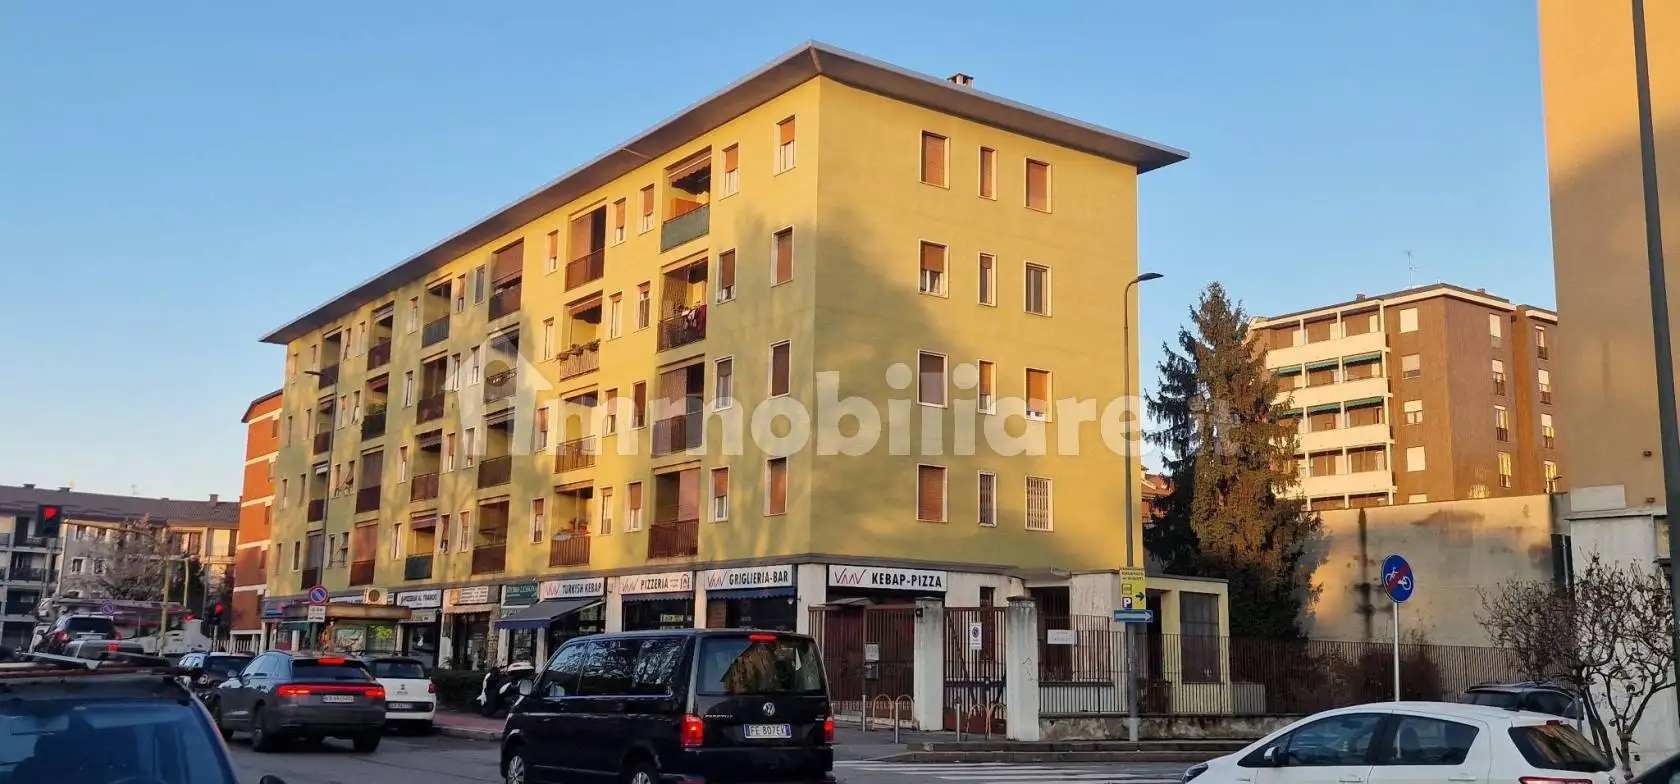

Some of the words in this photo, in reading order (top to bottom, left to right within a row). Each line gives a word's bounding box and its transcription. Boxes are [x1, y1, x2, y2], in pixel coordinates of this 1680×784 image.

[640, 577, 669, 590] PIZZERIA
[729, 569, 788, 585] GRIGLIERIA-BAR
[871, 571, 942, 588] KEBAP-PIZZA
[562, 583, 584, 595] TURKISH
[585, 581, 602, 593] KEBAP
[1123, 597, 1132, 608] P
